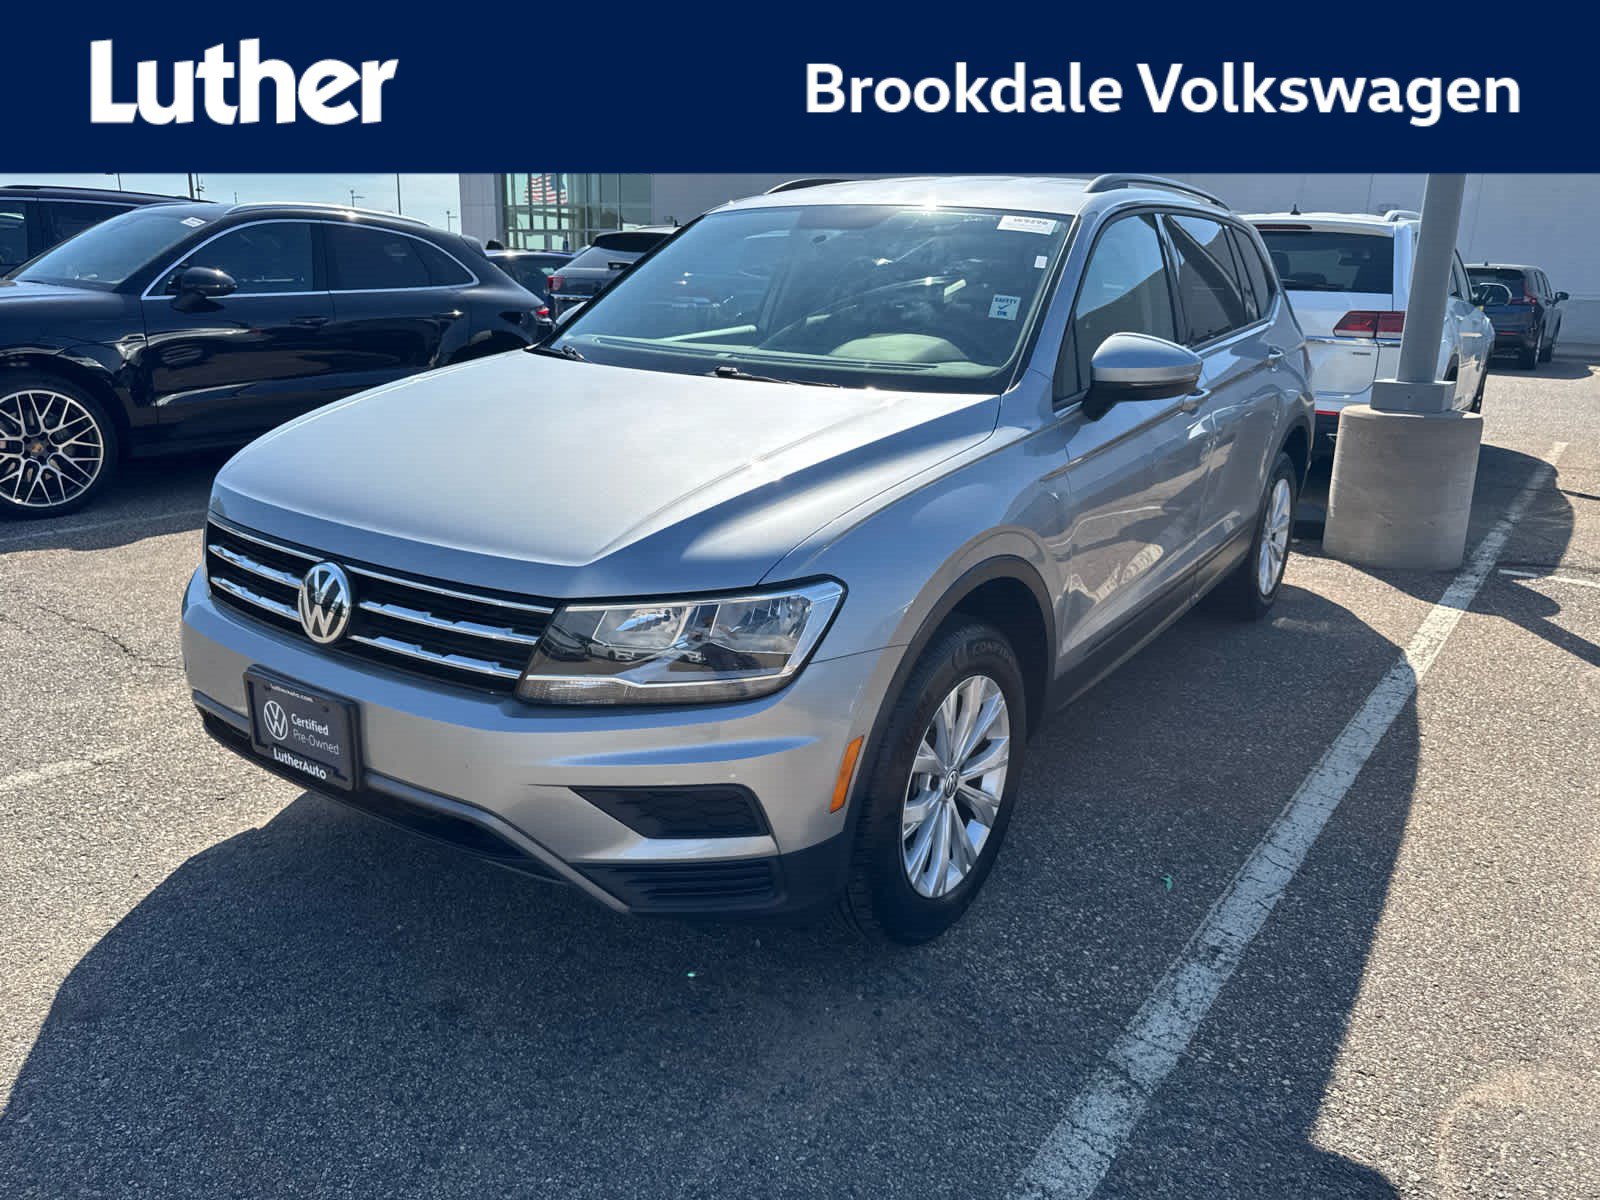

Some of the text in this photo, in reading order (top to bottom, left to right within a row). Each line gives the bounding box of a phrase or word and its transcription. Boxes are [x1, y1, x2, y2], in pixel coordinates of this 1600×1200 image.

[298, 562, 352, 645] VW
[263, 700, 288, 741] VW
[291, 712, 329, 736] Certified
[292, 728, 341, 756] Pre-Owned
[272, 747, 328, 781] LutherAuto
